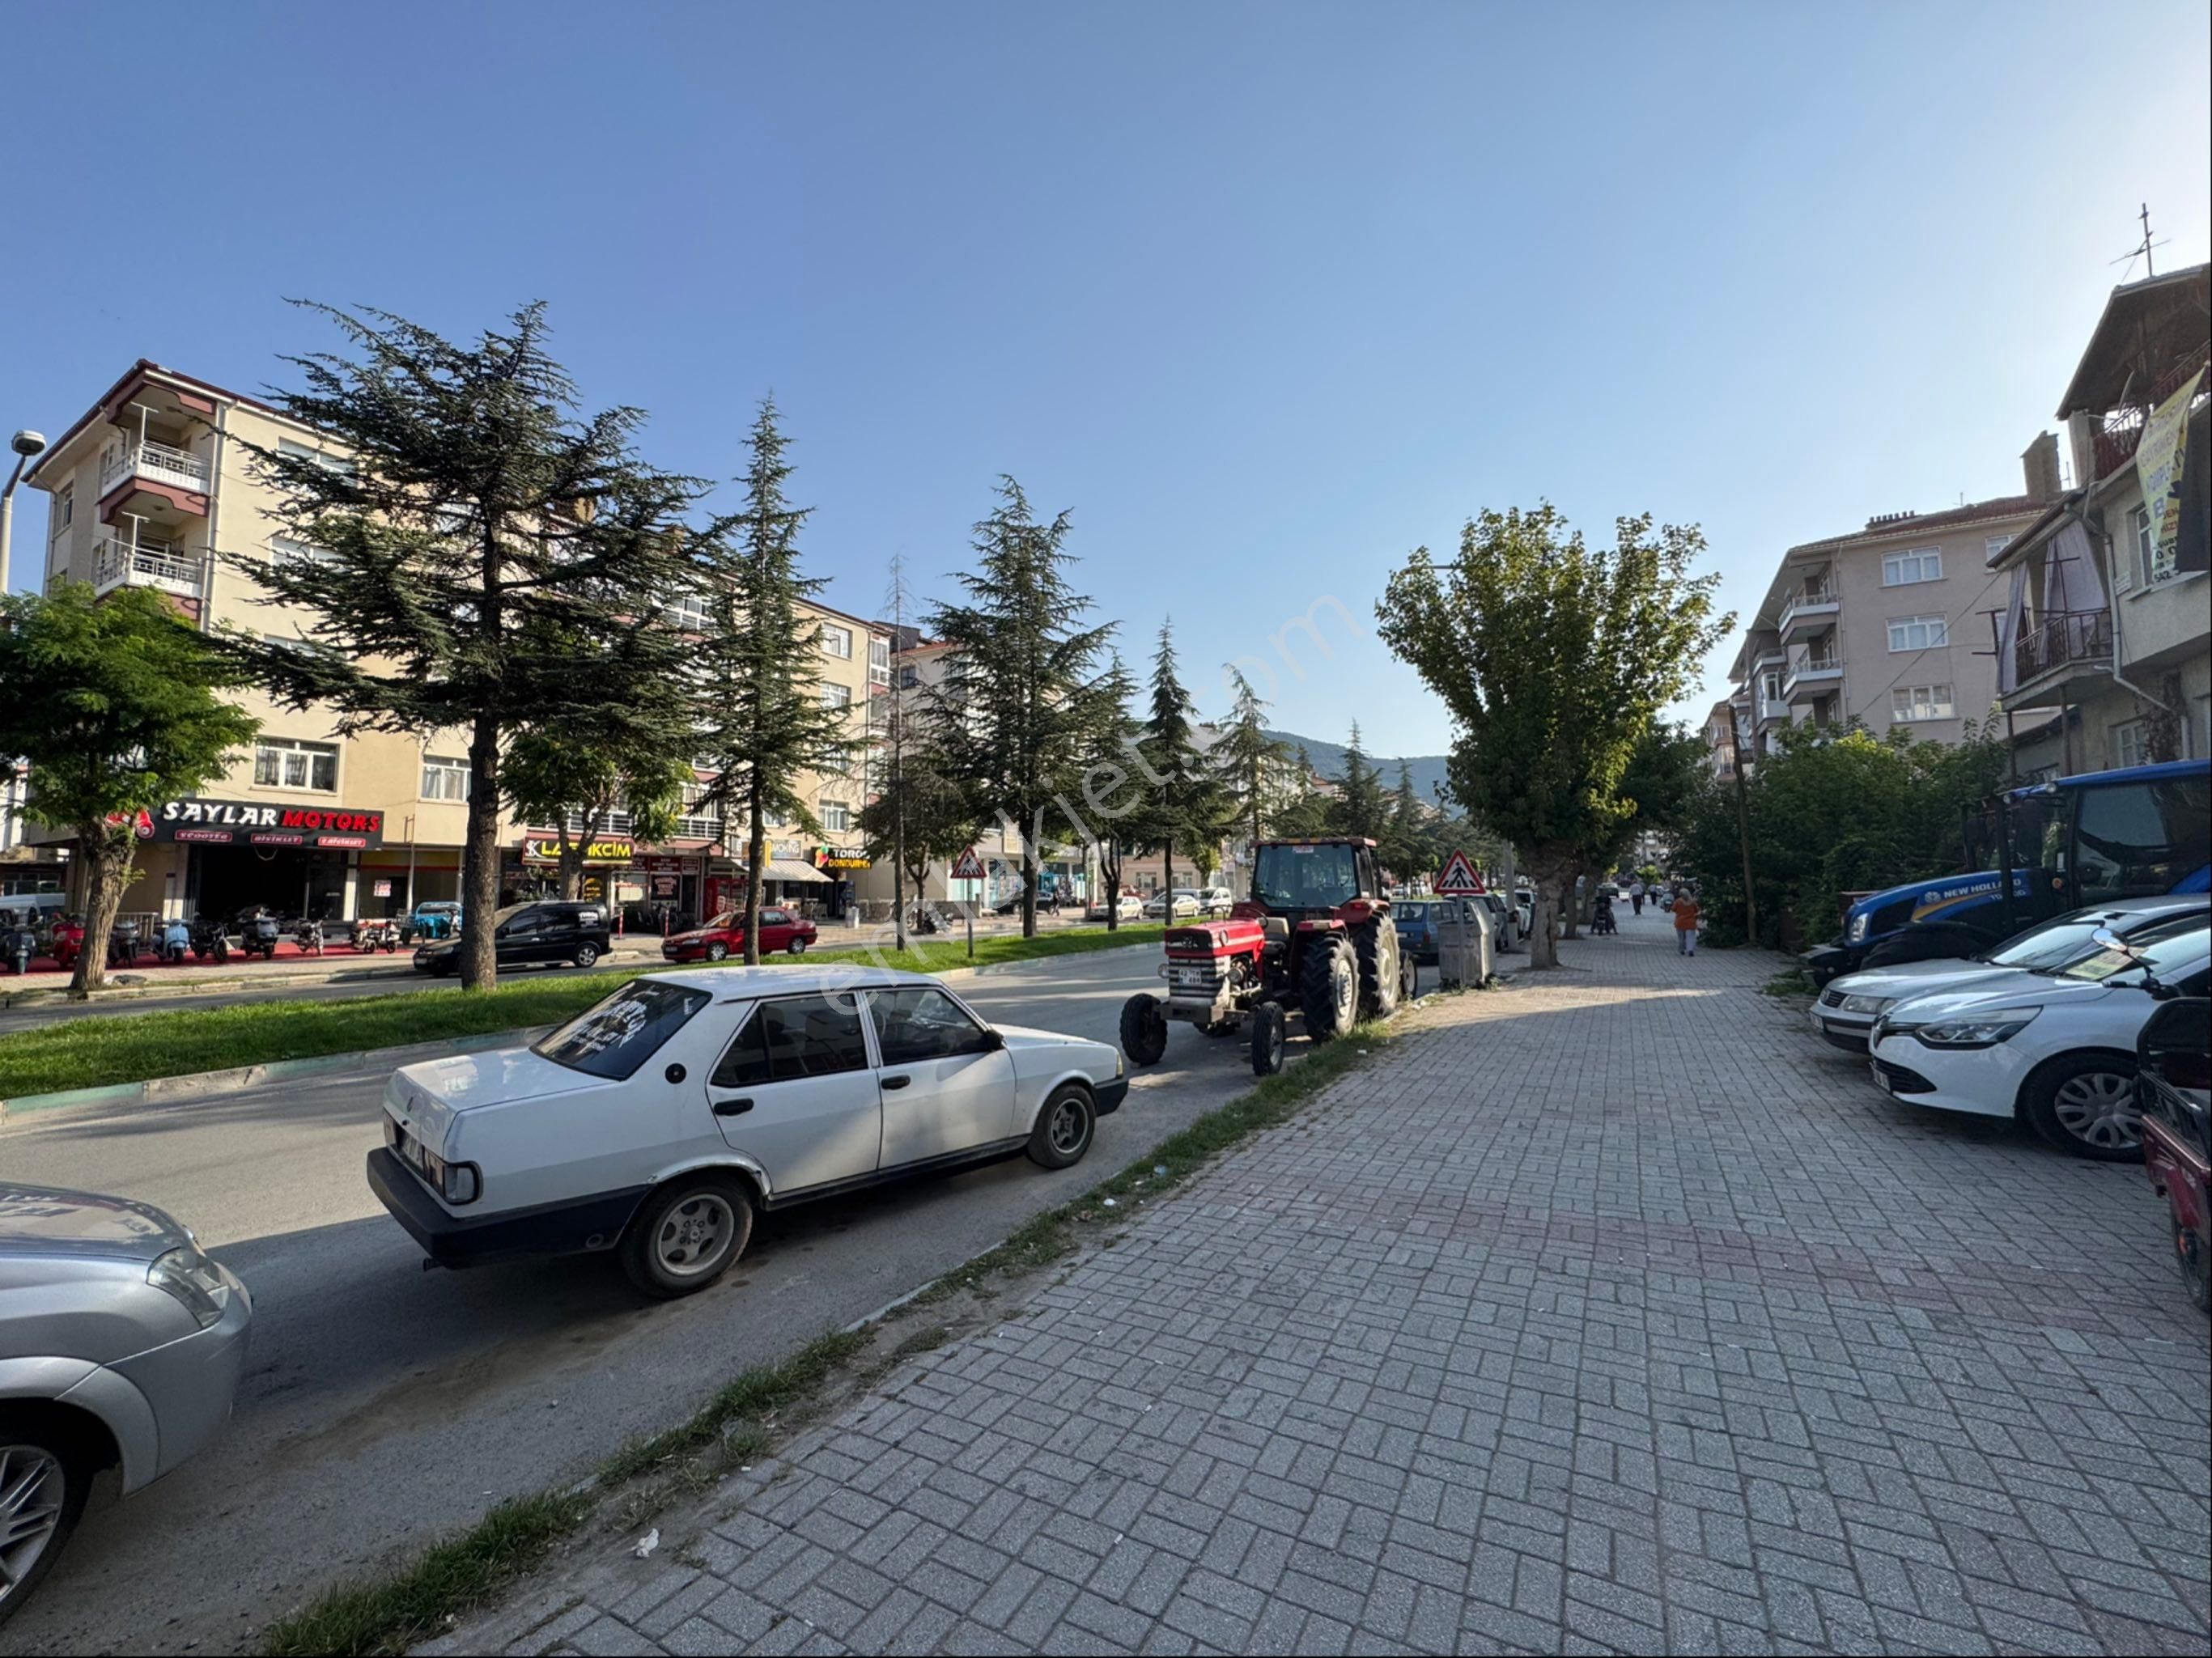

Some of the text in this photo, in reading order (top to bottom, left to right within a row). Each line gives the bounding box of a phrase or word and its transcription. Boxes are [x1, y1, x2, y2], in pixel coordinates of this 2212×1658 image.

[163, 801, 381, 832] SAYLAR MOTORS
[1943, 878, 2022, 899] NEW HOLLAD
